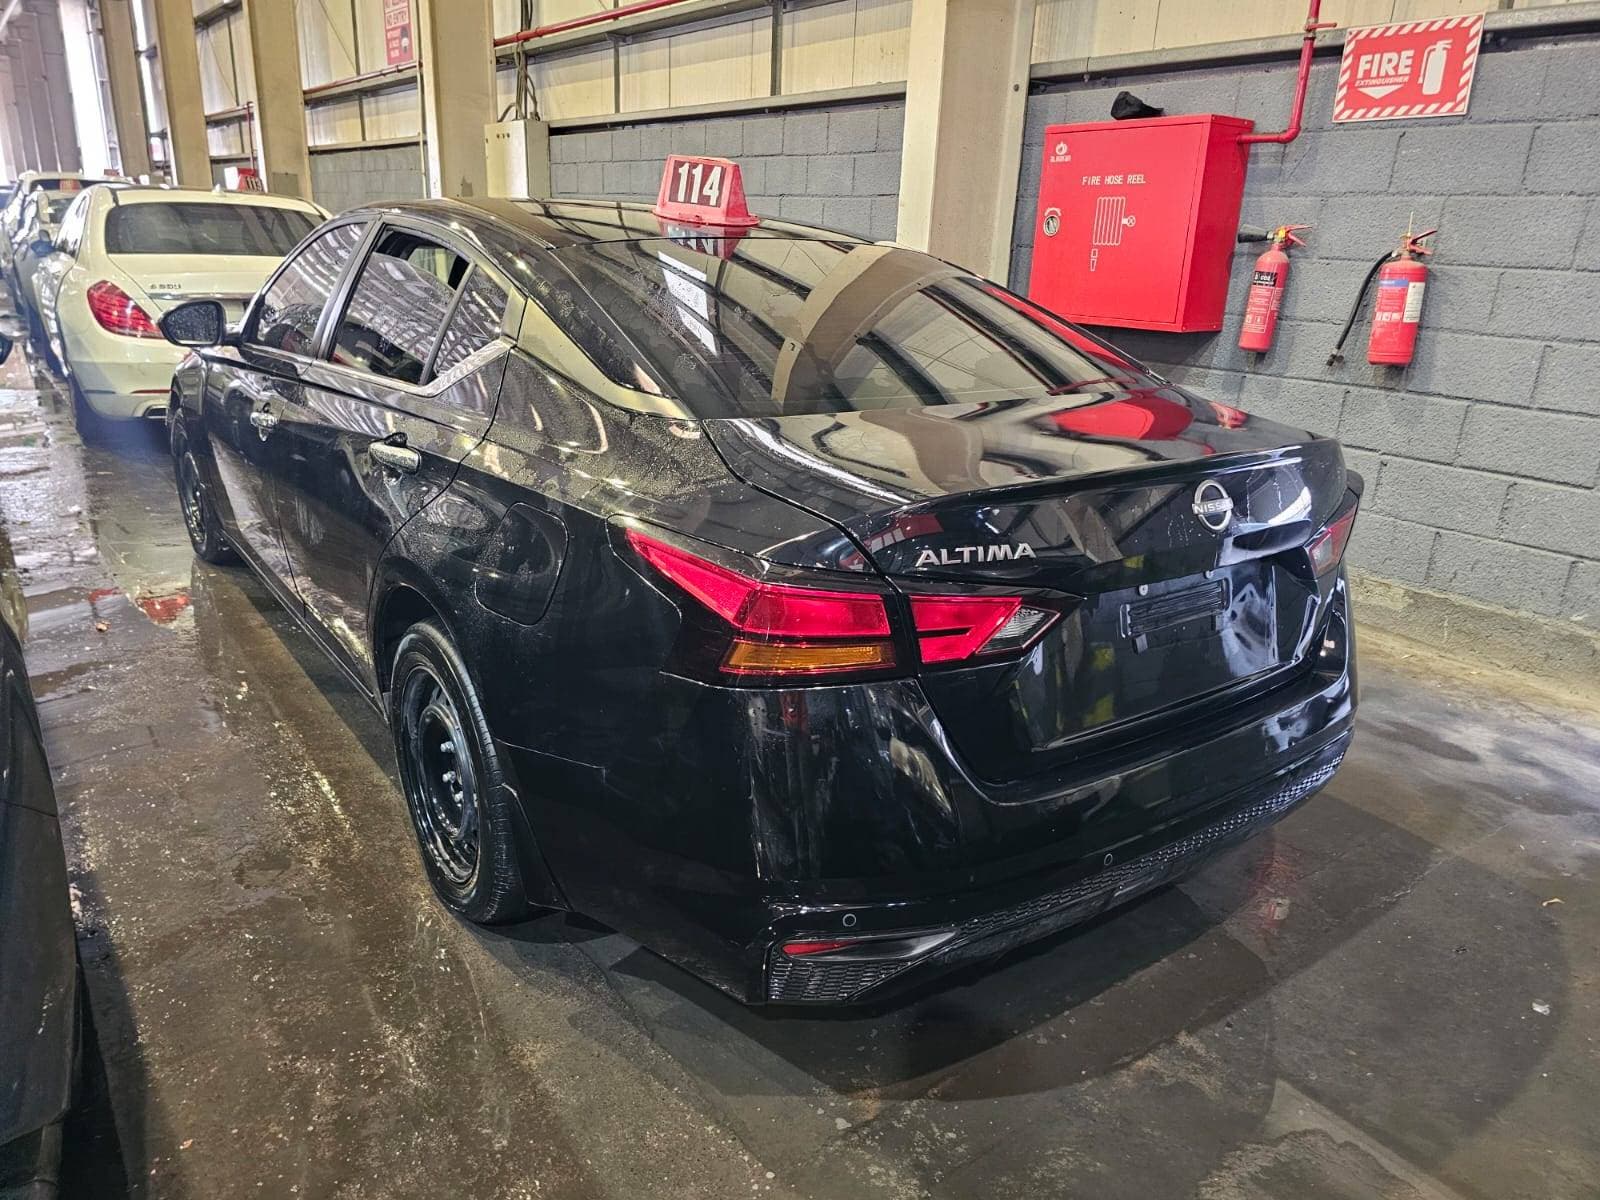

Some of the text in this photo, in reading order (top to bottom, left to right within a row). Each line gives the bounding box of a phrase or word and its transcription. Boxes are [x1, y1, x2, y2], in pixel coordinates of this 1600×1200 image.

[1357, 50, 1415, 79] FIRE
[1354, 76, 1410, 87] EXTINGUISHER
[677, 162, 722, 206] 114
[1082, 174, 1146, 185] FIRE HOSE REEL
[1193, 499, 1232, 514] NISS
[915, 543, 1036, 567] ALTIMA
